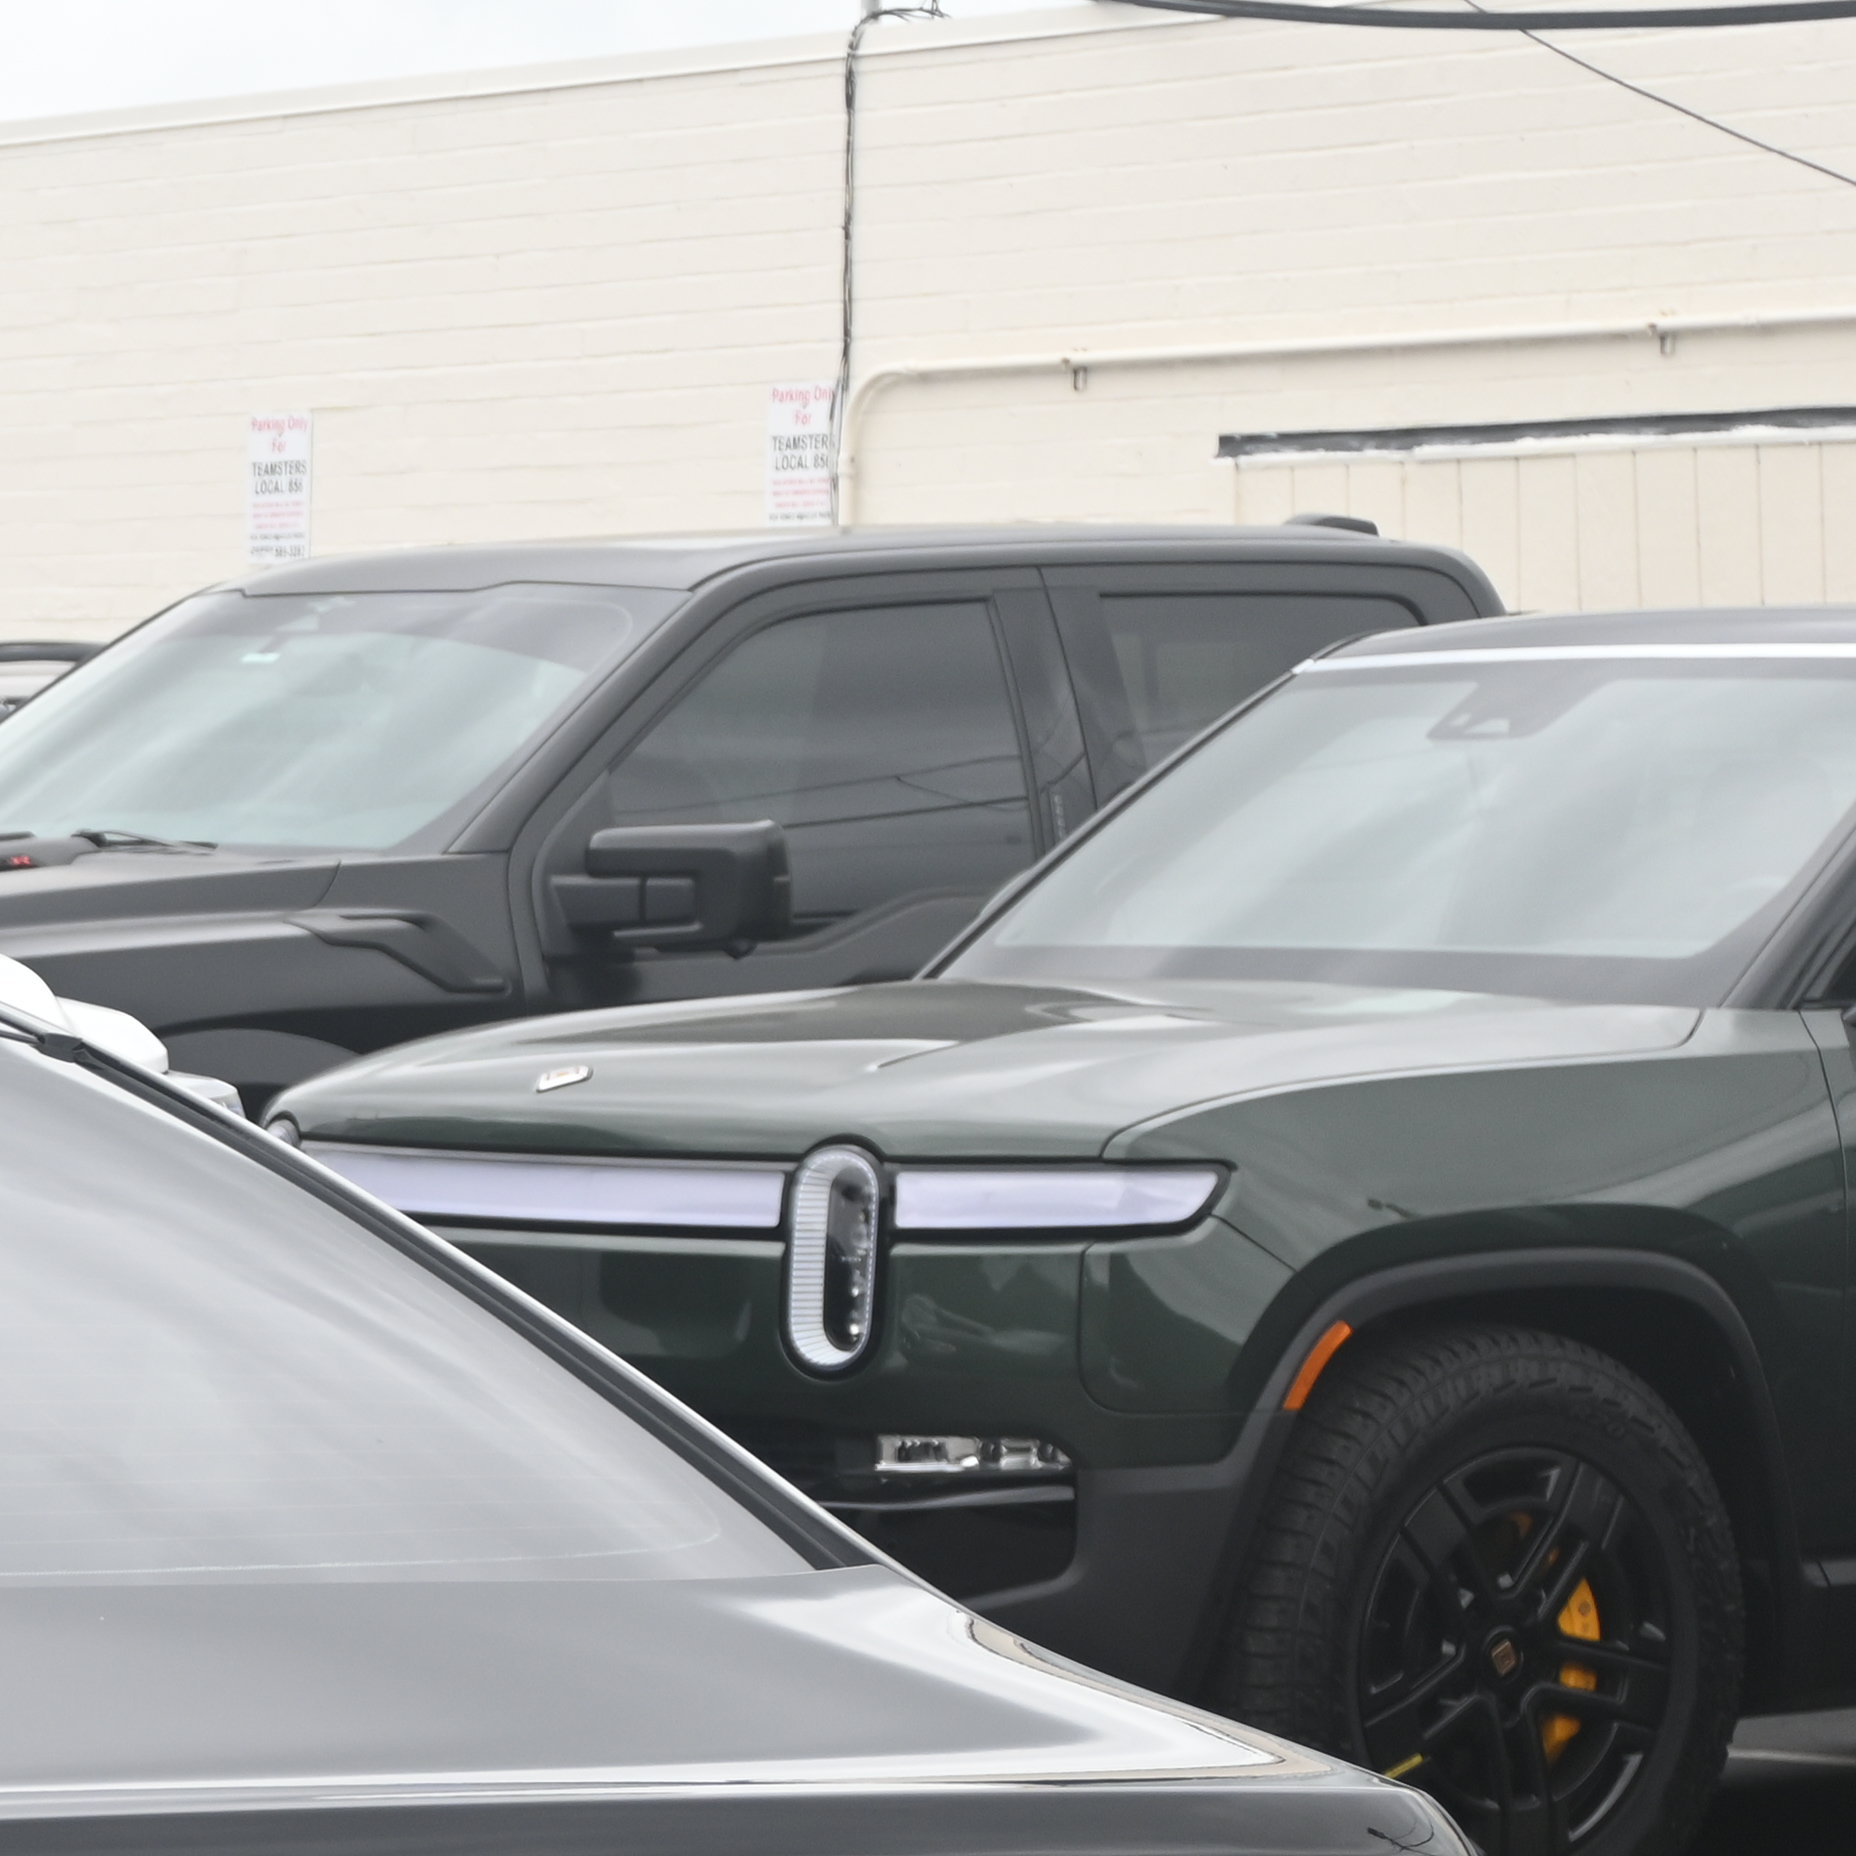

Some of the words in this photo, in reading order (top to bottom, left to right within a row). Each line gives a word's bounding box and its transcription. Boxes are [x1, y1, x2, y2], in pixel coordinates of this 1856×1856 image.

[771, 387, 810, 405] Parking
[251, 416, 285, 433] Parking
[288, 415, 308, 431] Only
[794, 410, 812, 425] For
[252, 460, 307, 477] TEAMSTERS
[775, 454, 808, 471] LOCAL
[255, 479, 284, 494] LOCAL
